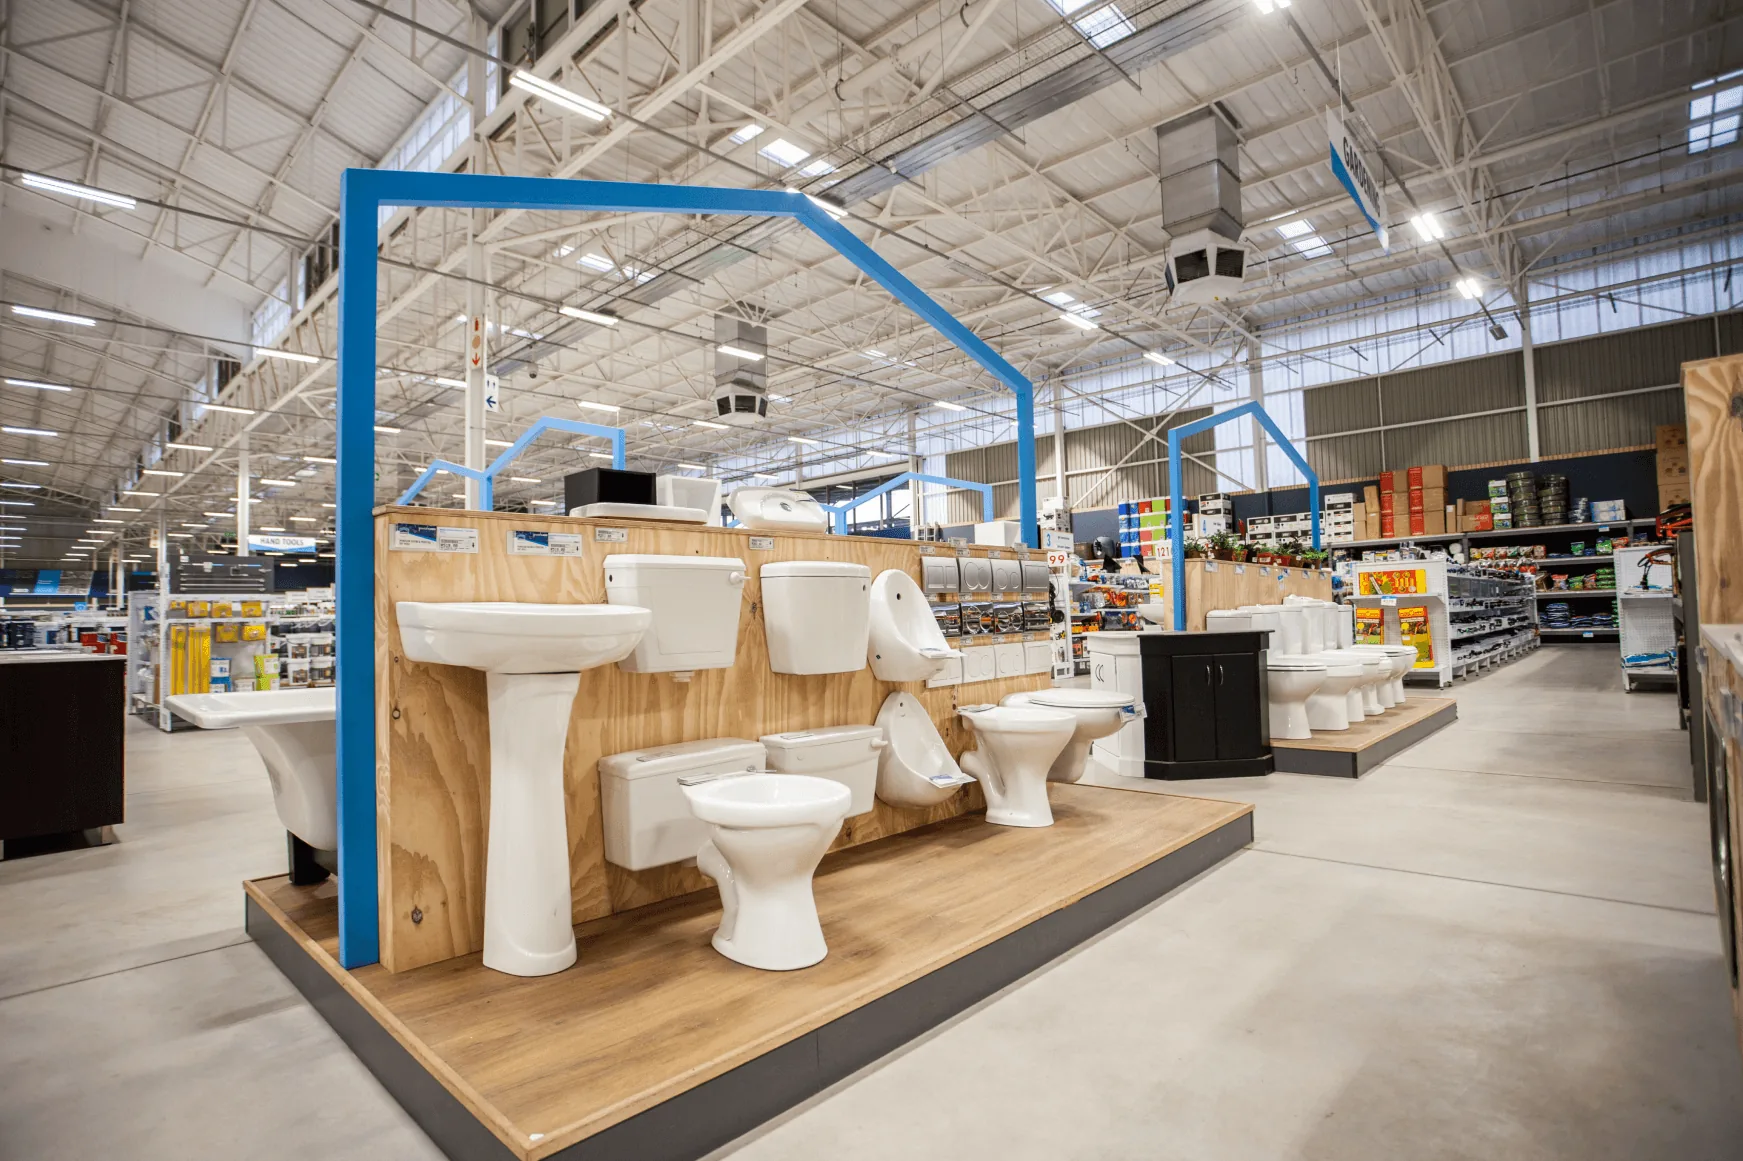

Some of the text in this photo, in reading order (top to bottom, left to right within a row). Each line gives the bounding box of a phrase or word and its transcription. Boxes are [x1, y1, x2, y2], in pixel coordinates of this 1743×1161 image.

[1342, 136, 1381, 218] GARDENING
[260, 537, 304, 546] HAND TOOLS
[1046, 533, 1051, 547] 3
